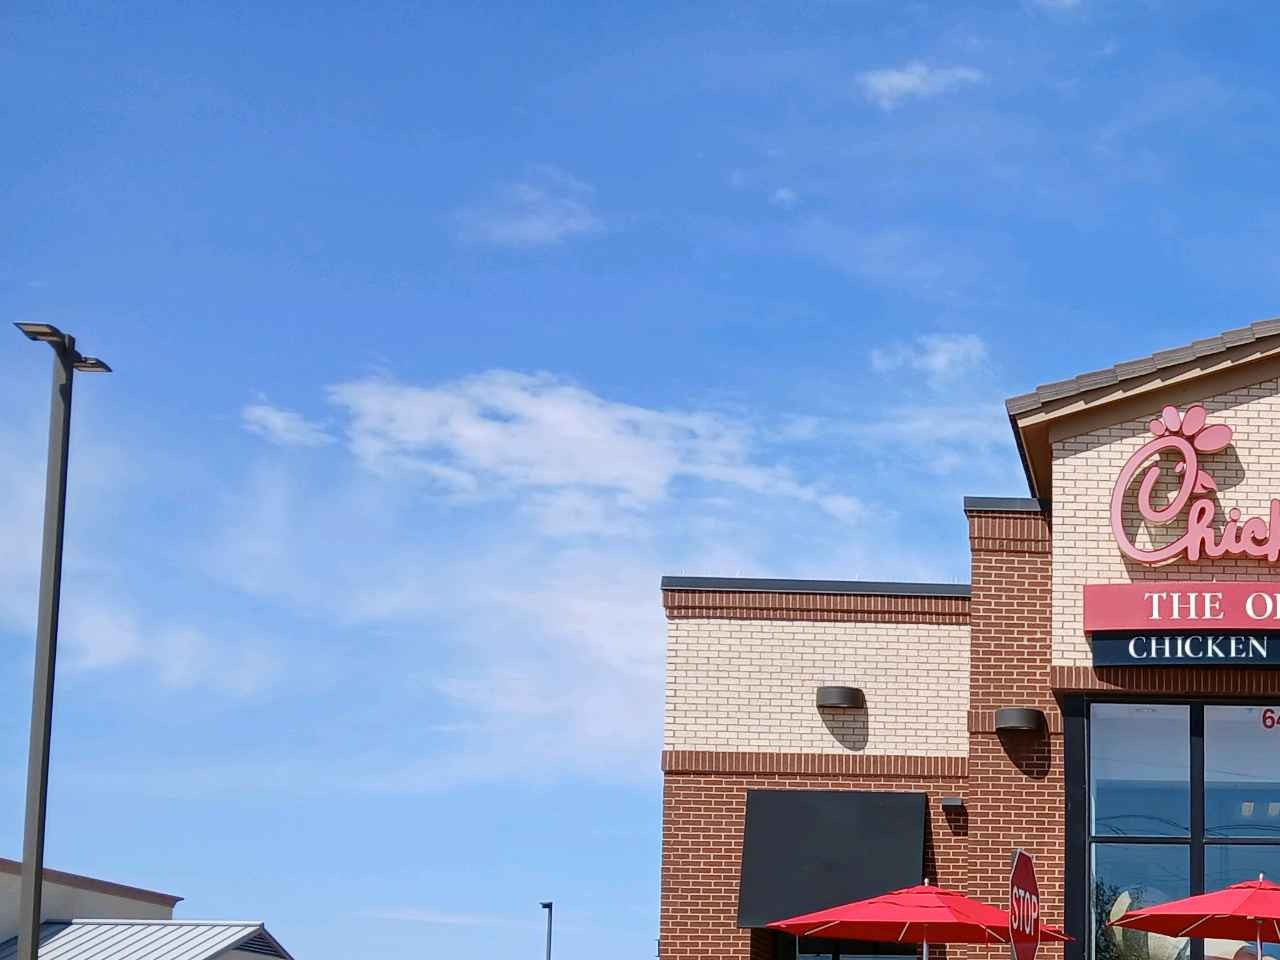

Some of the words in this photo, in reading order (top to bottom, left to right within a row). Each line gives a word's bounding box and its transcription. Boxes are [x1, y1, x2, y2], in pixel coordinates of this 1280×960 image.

[1144, 591, 1225, 620] THE
[1127, 635, 1268, 660] CHICKEN
[1011, 886, 1038, 936] STOP
